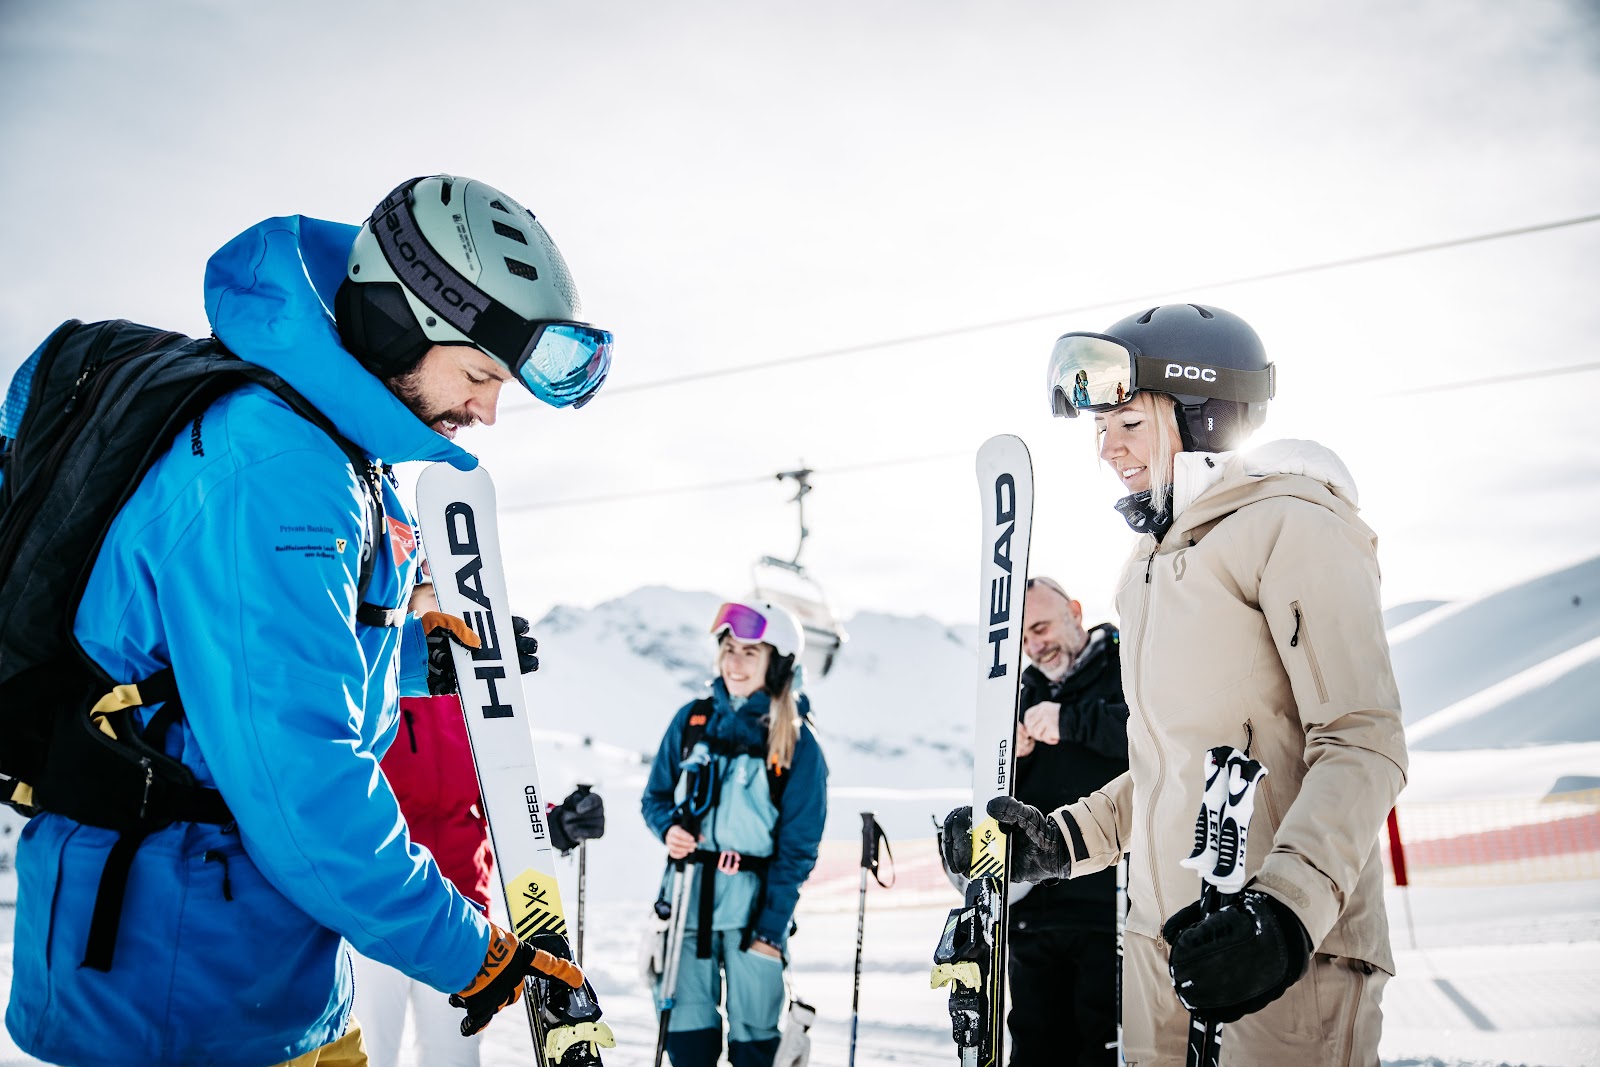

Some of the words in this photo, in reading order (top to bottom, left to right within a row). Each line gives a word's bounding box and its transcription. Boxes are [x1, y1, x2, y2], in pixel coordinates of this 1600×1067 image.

[988, 473, 1016, 679] HEAD
[445, 501, 514, 719] HEAD
[997, 739, 1007, 791] I.SPEED
[524, 785, 545, 840] I.SPEED
[1209, 809, 1218, 852] LEKI
